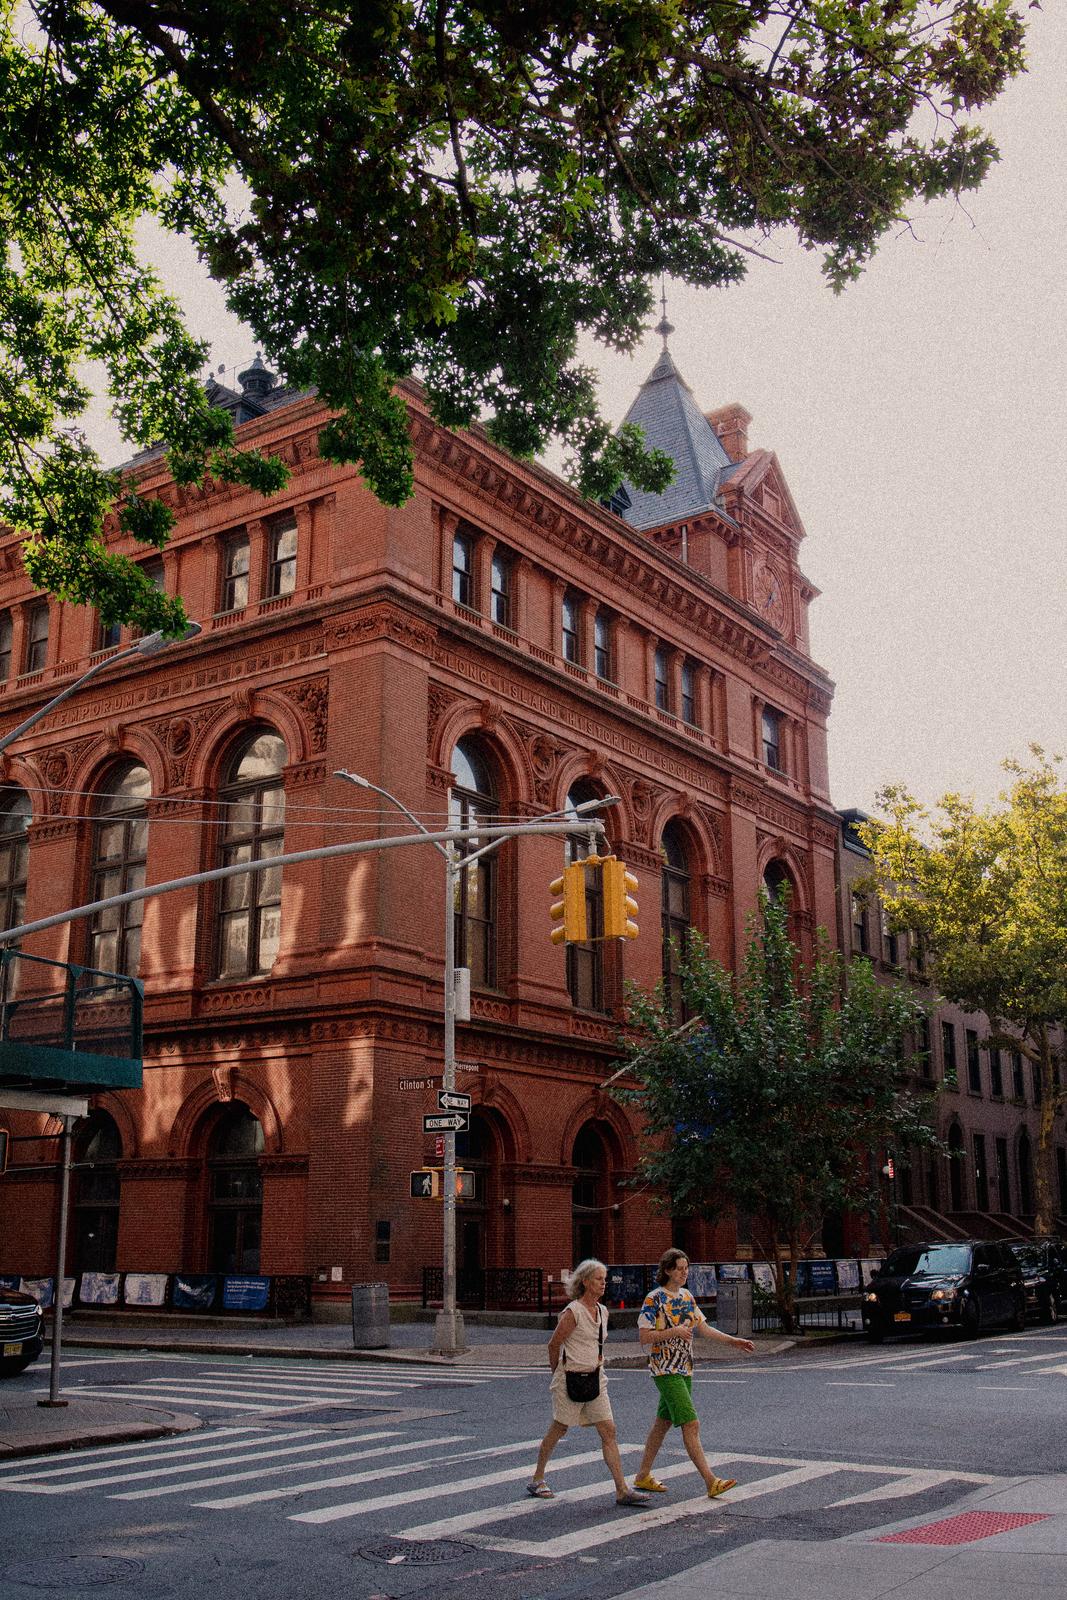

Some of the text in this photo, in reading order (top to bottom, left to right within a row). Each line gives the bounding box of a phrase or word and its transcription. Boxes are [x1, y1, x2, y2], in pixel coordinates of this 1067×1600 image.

[49, 691, 136, 730] TEMPORUM
[502, 679, 557, 719] ISLAND
[568, 712, 652, 762] HISTORICAL
[661, 758, 711, 790] SOCIETY
[399, 1079, 434, 1090] Clinton St
[443, 1096, 467, 1107] ONE WAY
[429, 1118, 461, 1127] ONE WAY
